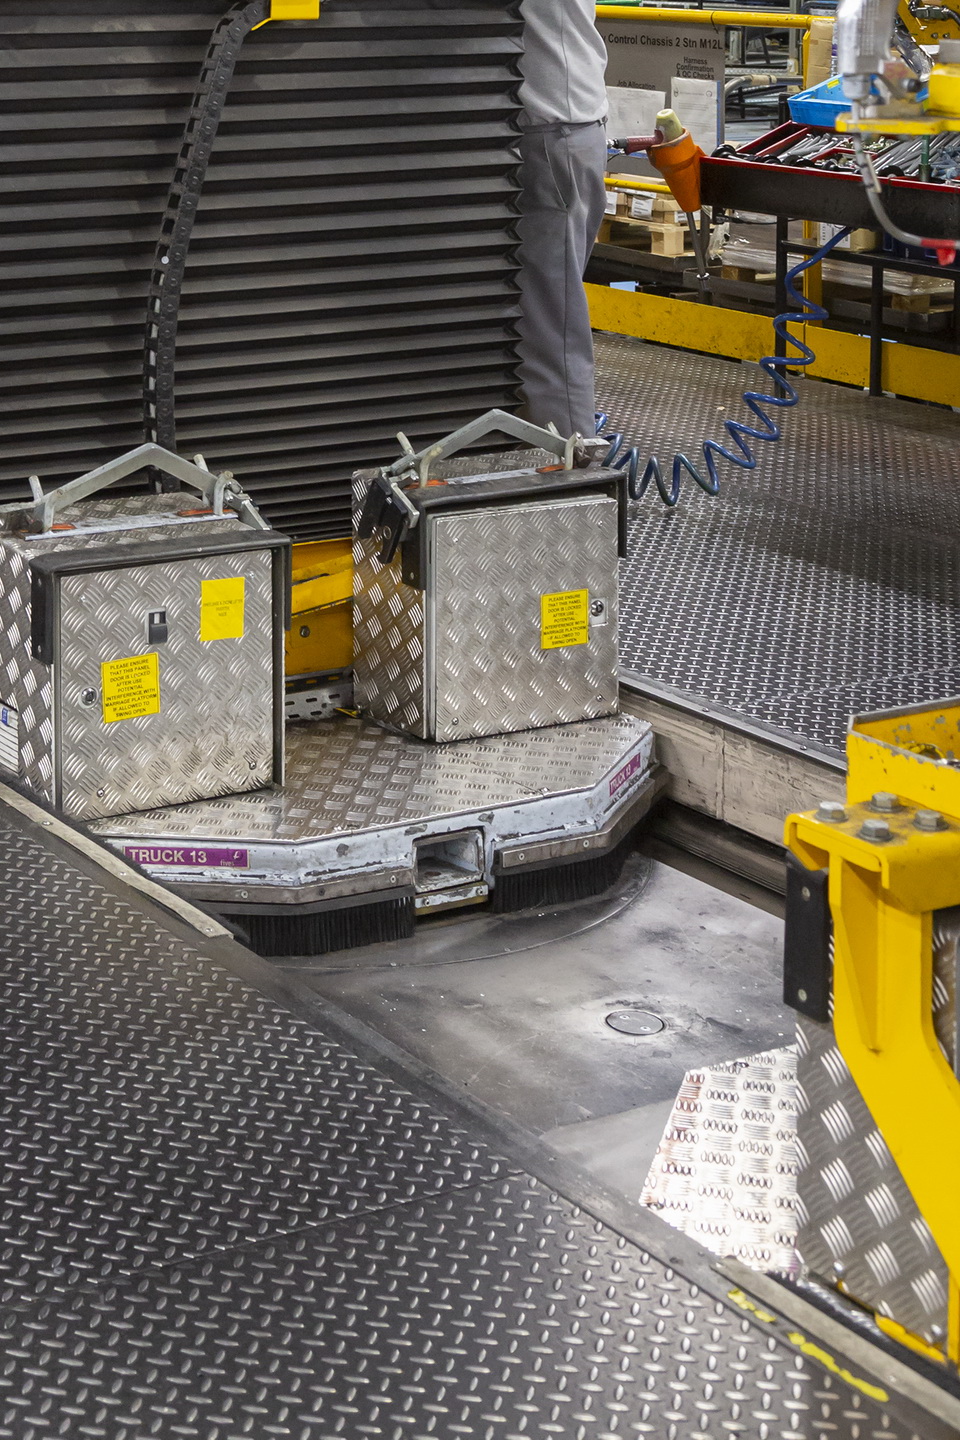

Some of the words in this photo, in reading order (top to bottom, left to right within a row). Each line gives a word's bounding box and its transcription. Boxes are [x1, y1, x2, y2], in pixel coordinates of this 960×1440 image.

[608, 34, 637, 44] Control
[640, 35, 673, 47] Chassis
[675, 37, 680, 47] 2
[683, 37, 697, 48] Stn
[700, 39, 723, 50] M12L
[684, 57, 707, 65] Harness
[676, 63, 714, 73] Confirmation
[693, 71, 714, 80] Checks
[629, 81, 656, 90] Allocation
[106, 691, 142, 701] INTERFERENCE
[106, 699, 130, 707] MARRIAGE
[132, 693, 156, 701] PLATFORM
[119, 703, 142, 711] ALLOWED
[129, 849, 185, 863] TRUCK
[190, 851, 207, 863] 13
